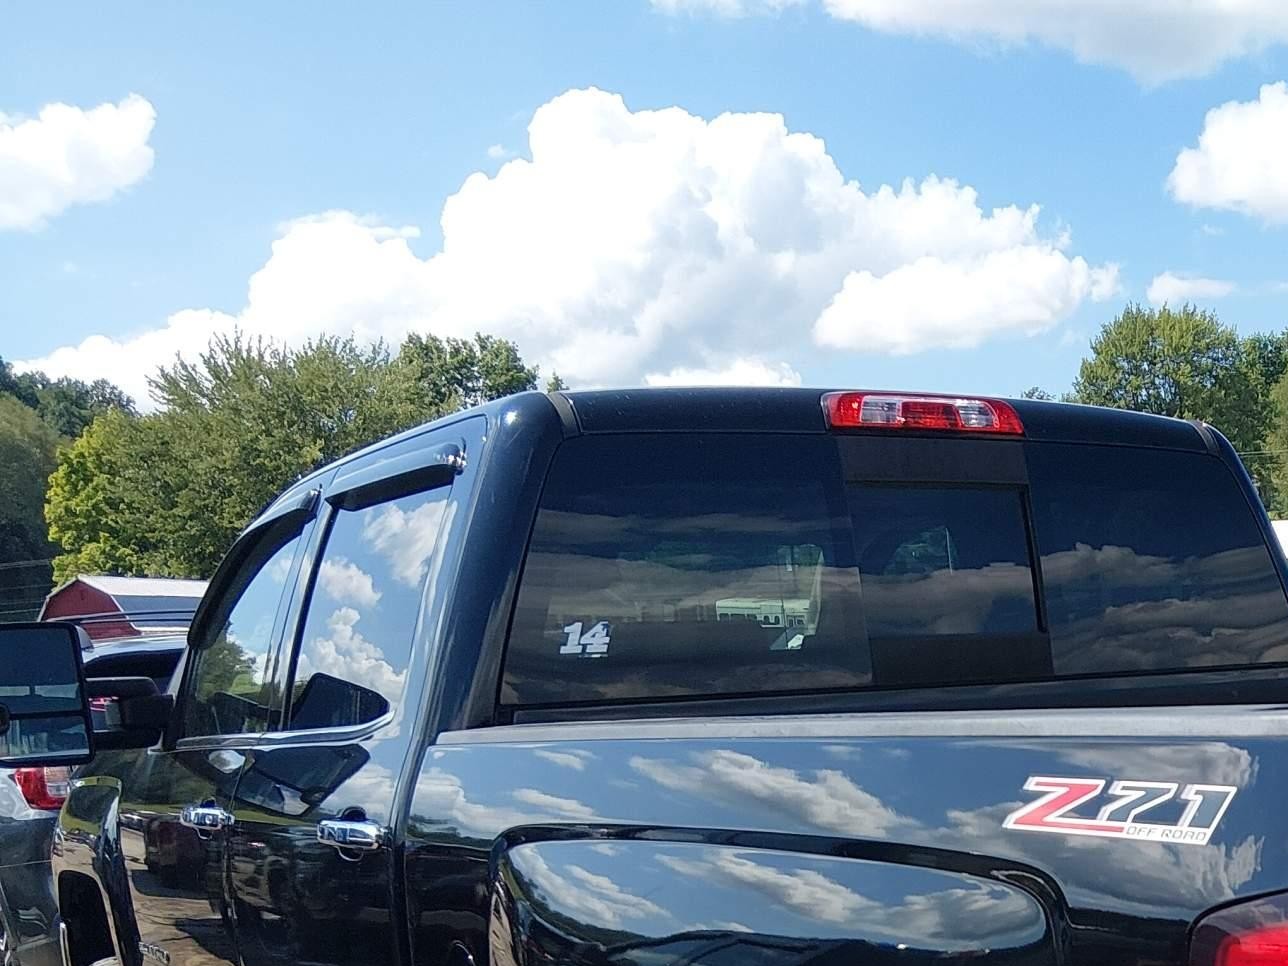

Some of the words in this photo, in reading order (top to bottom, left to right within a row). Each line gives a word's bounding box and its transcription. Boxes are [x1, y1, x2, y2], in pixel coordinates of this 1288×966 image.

[559, 620, 611, 655] 14
[1002, 776, 1237, 838] Z71
[1125, 825, 1158, 837] OFF
[1160, 828, 1207, 841] ROAD
